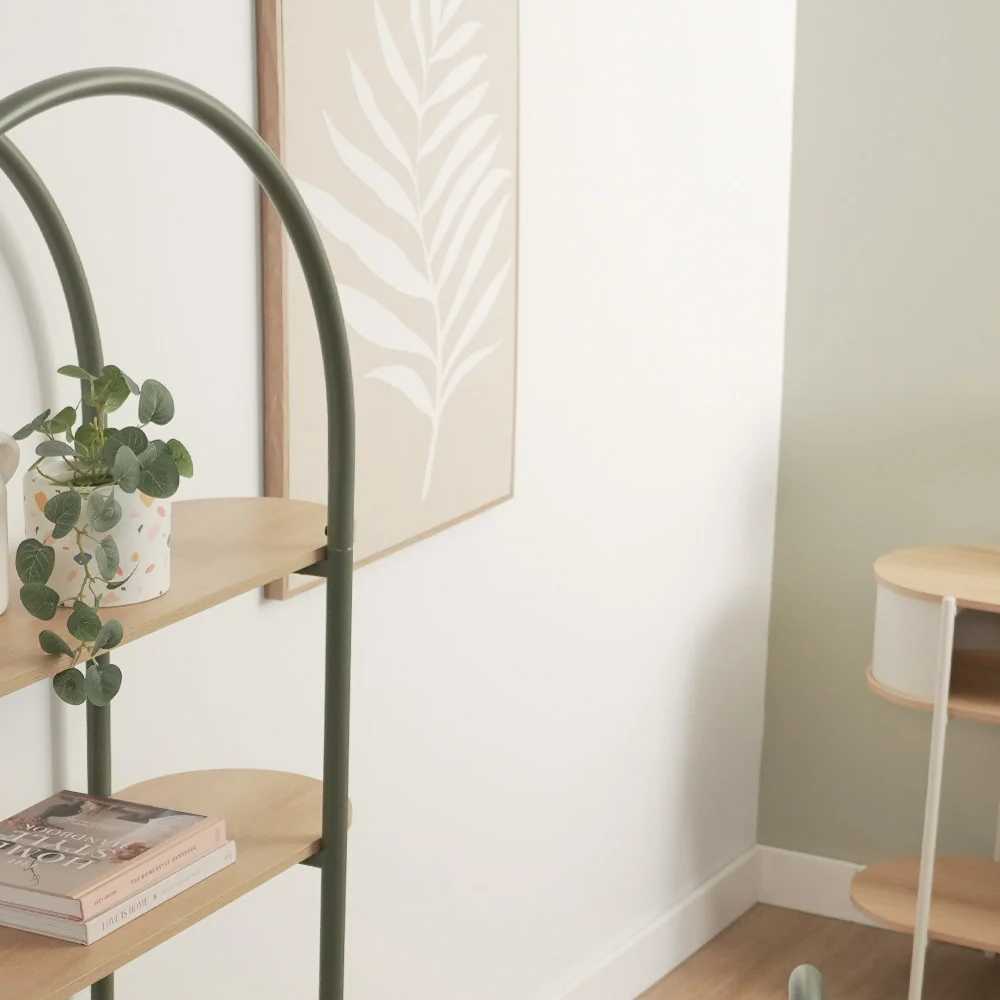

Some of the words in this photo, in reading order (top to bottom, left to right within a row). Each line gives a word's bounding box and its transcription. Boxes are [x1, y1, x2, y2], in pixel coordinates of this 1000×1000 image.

[11, 829, 116, 859] STYLE
[25, 823, 128, 850] HANDBOOK
[102, 915, 119, 931] LOVE
[120, 909, 128, 920] IS
[128, 897, 148, 915] HOME
